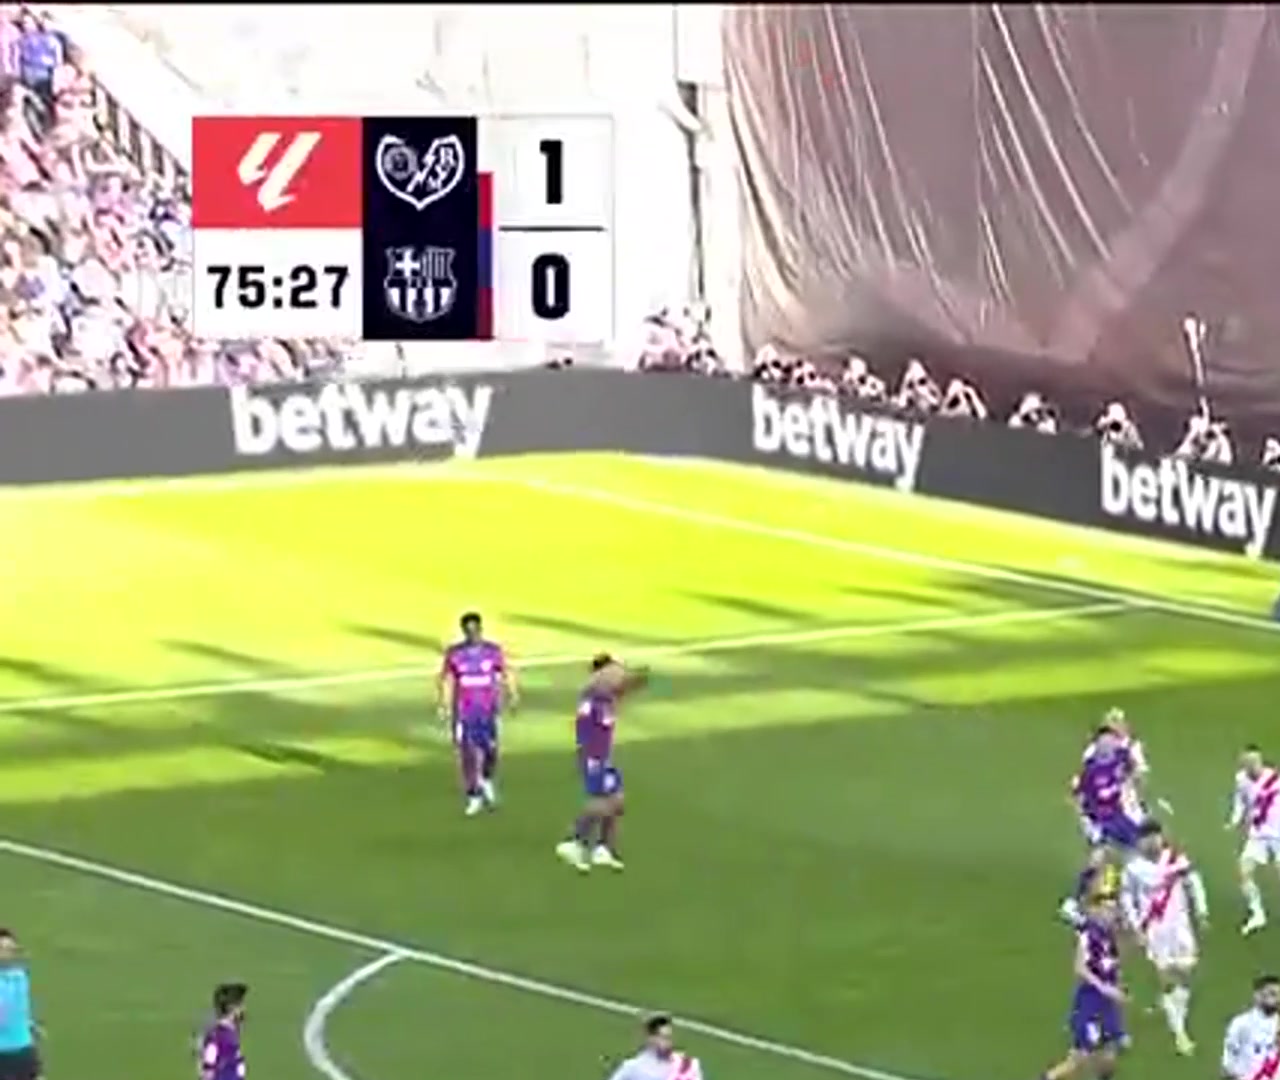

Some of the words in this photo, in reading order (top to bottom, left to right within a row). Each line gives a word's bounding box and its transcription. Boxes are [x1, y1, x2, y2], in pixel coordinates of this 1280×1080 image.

[231, 383, 492, 458] betway
[752, 388, 924, 492] betway
[1100, 446, 1276, 558] betway
